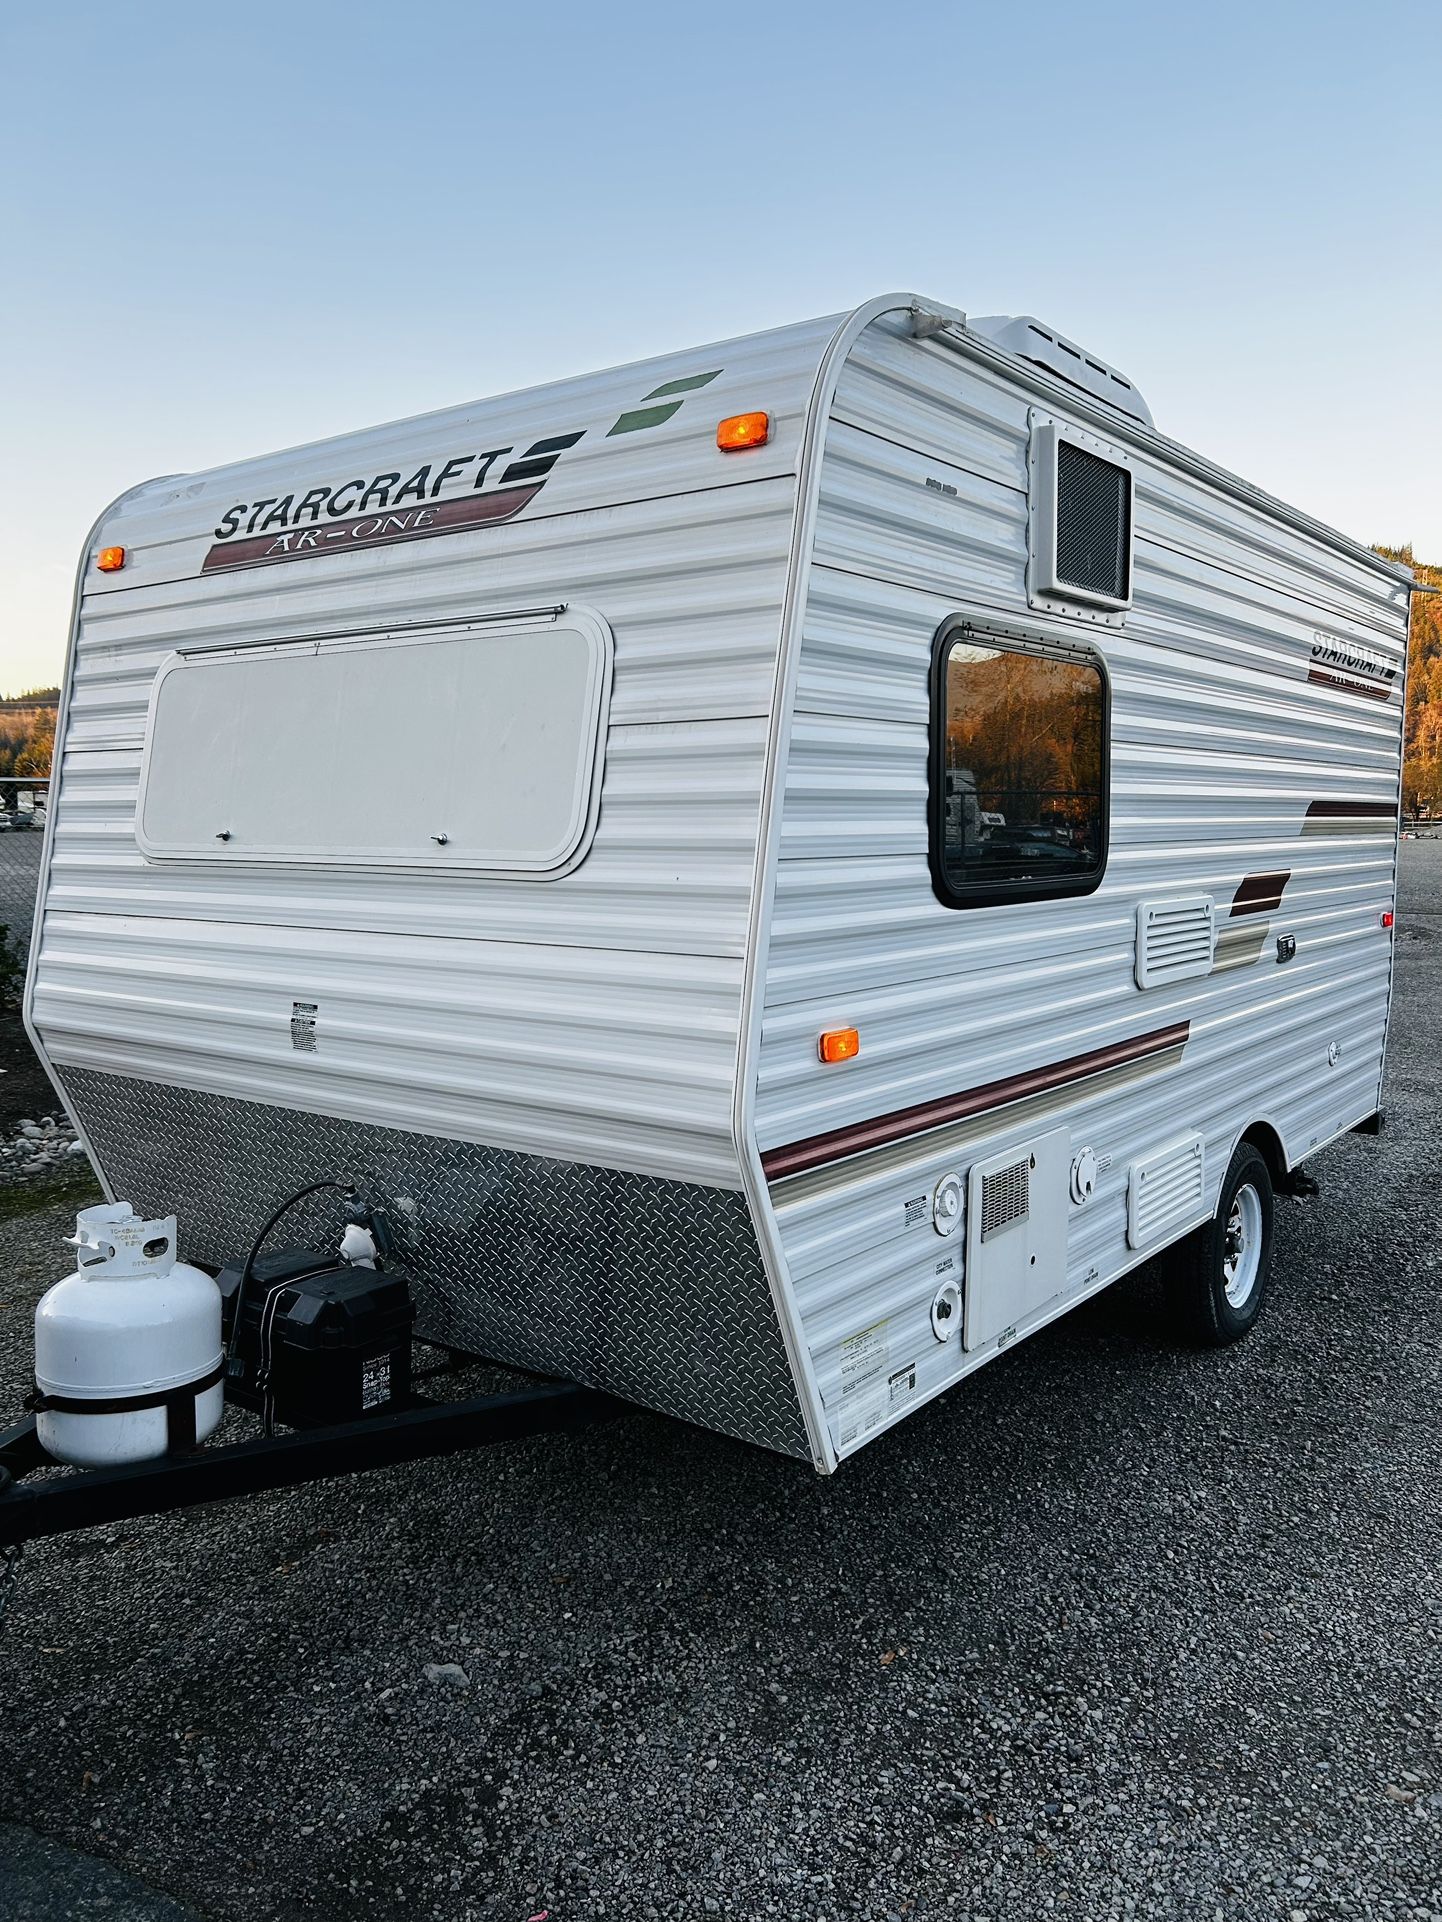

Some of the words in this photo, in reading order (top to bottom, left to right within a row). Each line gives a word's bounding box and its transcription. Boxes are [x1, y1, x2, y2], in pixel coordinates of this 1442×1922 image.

[214, 446, 514, 539] STARCRAFT
[265, 507, 441, 555] AR-ONE
[1311, 631, 1387, 676] STARCRAFT
